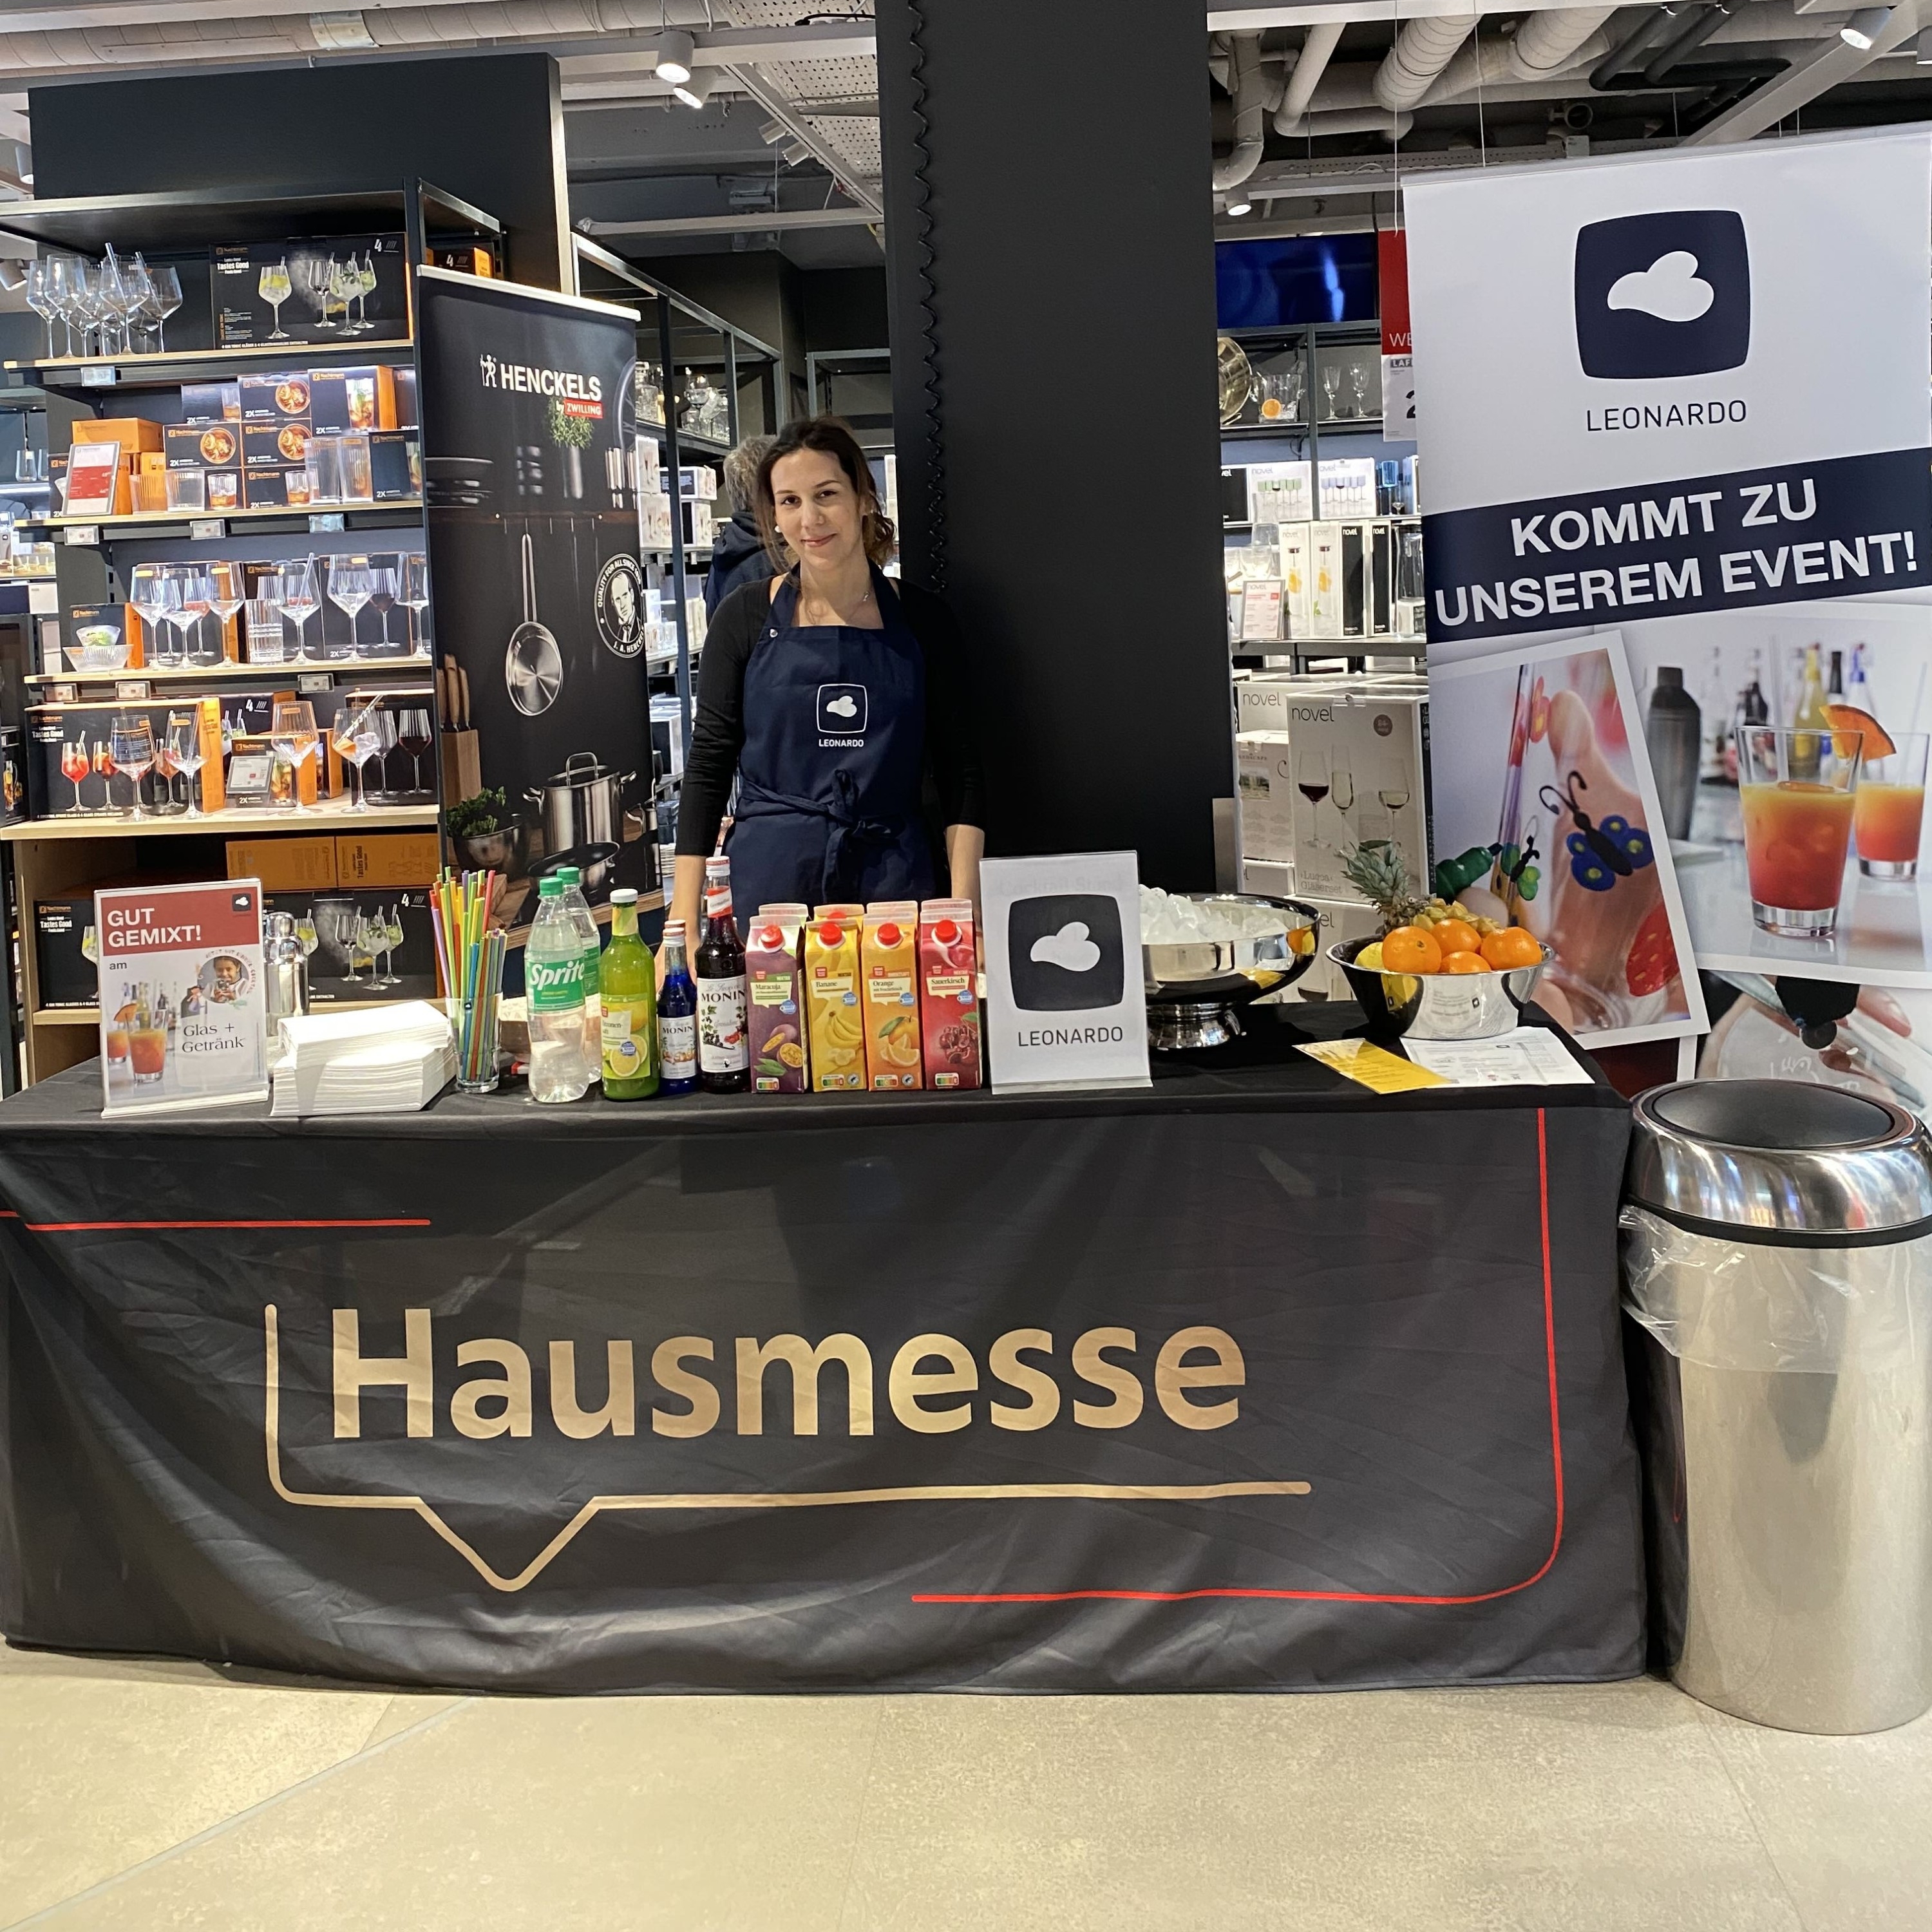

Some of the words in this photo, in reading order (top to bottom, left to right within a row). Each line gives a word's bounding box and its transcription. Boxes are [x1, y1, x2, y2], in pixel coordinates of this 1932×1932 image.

[375, 239, 382, 252] 4
[446, 254, 453, 267] 4
[500, 363, 602, 402] HENCKELS
[556, 400, 565, 414] by
[567, 402, 601, 415] ZWILLING
[1587, 400, 1747, 431] LEONARDO
[1511, 491, 1723, 556] KOMMT
[1739, 478, 1816, 527] ZU
[598, 574, 607, 607] QUALITY
[605, 564, 615, 576] FOR
[1435, 557, 1702, 626] UNSEREM
[1719, 530, 1917, 592] EVENT!
[620, 644, 626, 653] A.
[246, 699, 254, 712] 4
[1243, 692, 1281, 706] novel
[1292, 706, 1334, 722] novel
[819, 739, 864, 747] LEONARDO
[401, 894, 410, 907] 4
[108, 908, 155, 927] GUT
[108, 925, 202, 947] GEMIXT!
[109, 961, 128, 971] am
[529, 960, 584, 990] Sprite
[701, 989, 745, 1003] MONIN
[183, 1023, 218, 1037] Glas
[663, 1026, 692, 1034] MONIN
[1018, 1027, 1123, 1047] LEONARDO
[182, 1037, 246, 1054] Getränk
[333, 1307, 1247, 1440] Hausmesse
